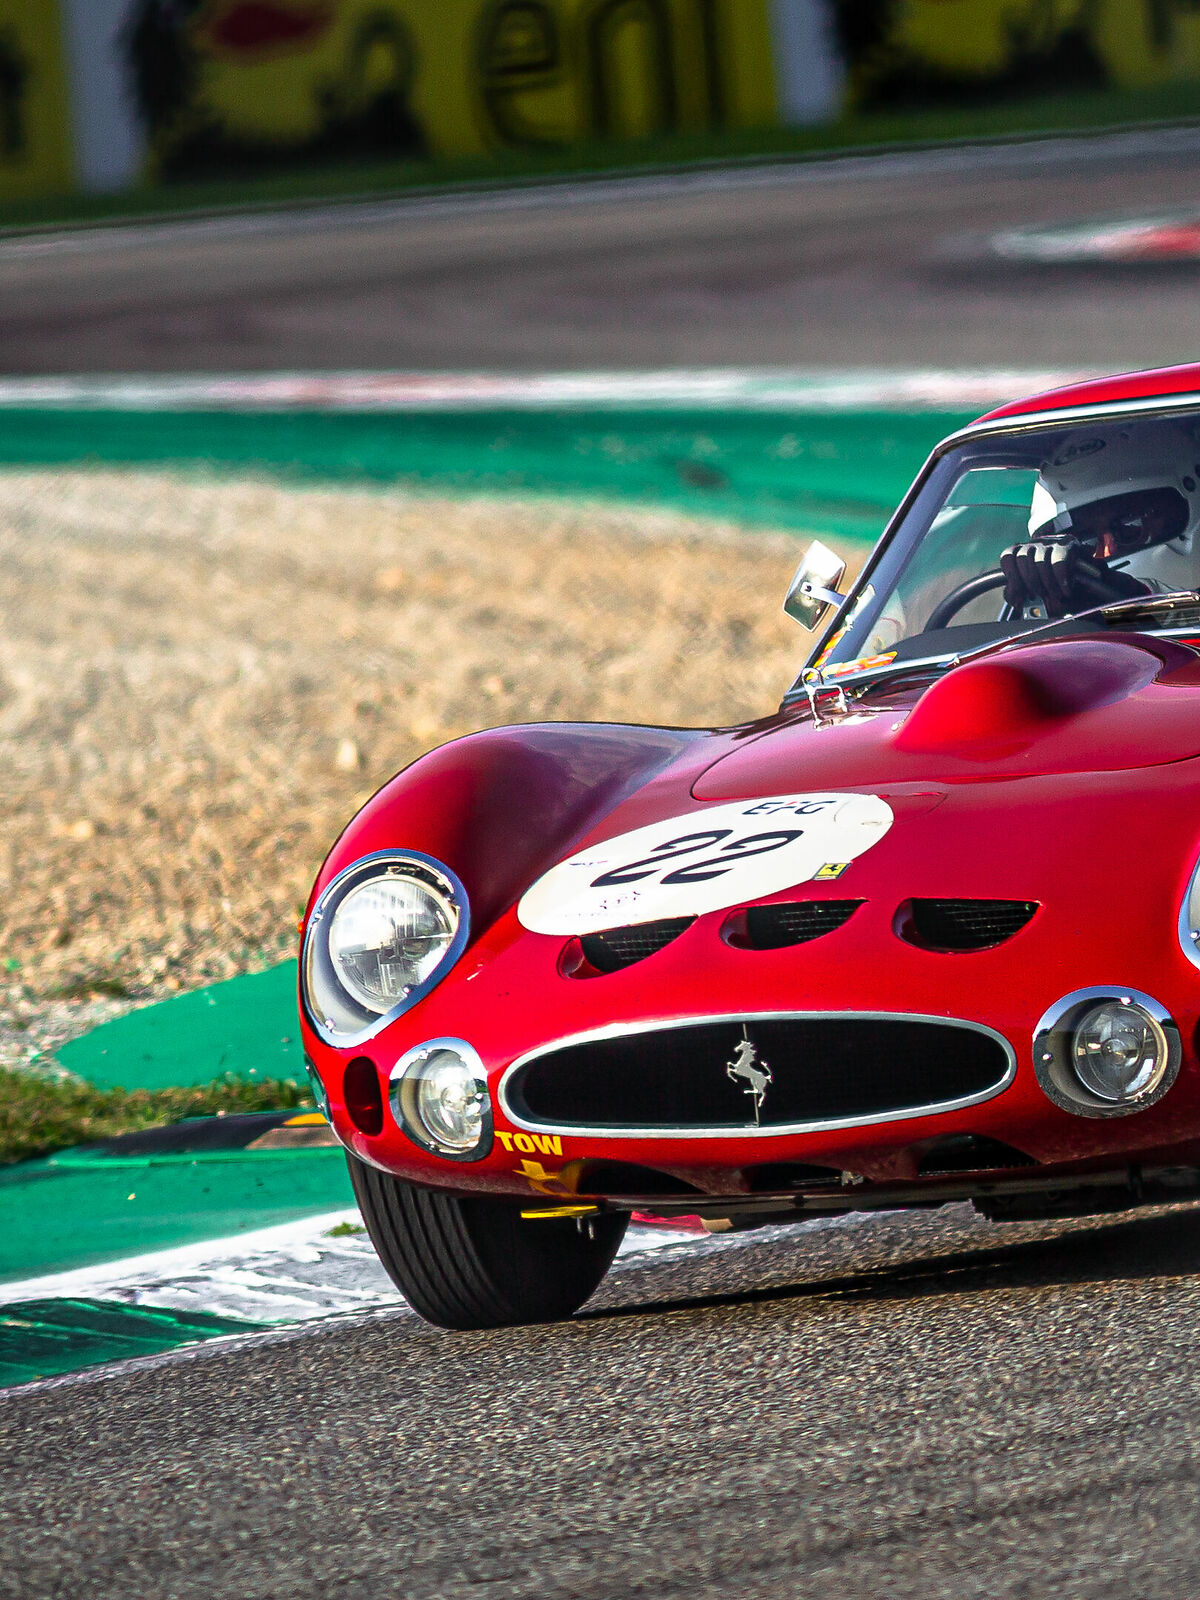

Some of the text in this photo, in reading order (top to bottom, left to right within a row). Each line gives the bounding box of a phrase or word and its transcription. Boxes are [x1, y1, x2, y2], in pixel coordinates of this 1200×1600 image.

[742, 800, 837, 815] EFG
[589, 829, 805, 888] 22
[494, 1131, 563, 1156] TOW
